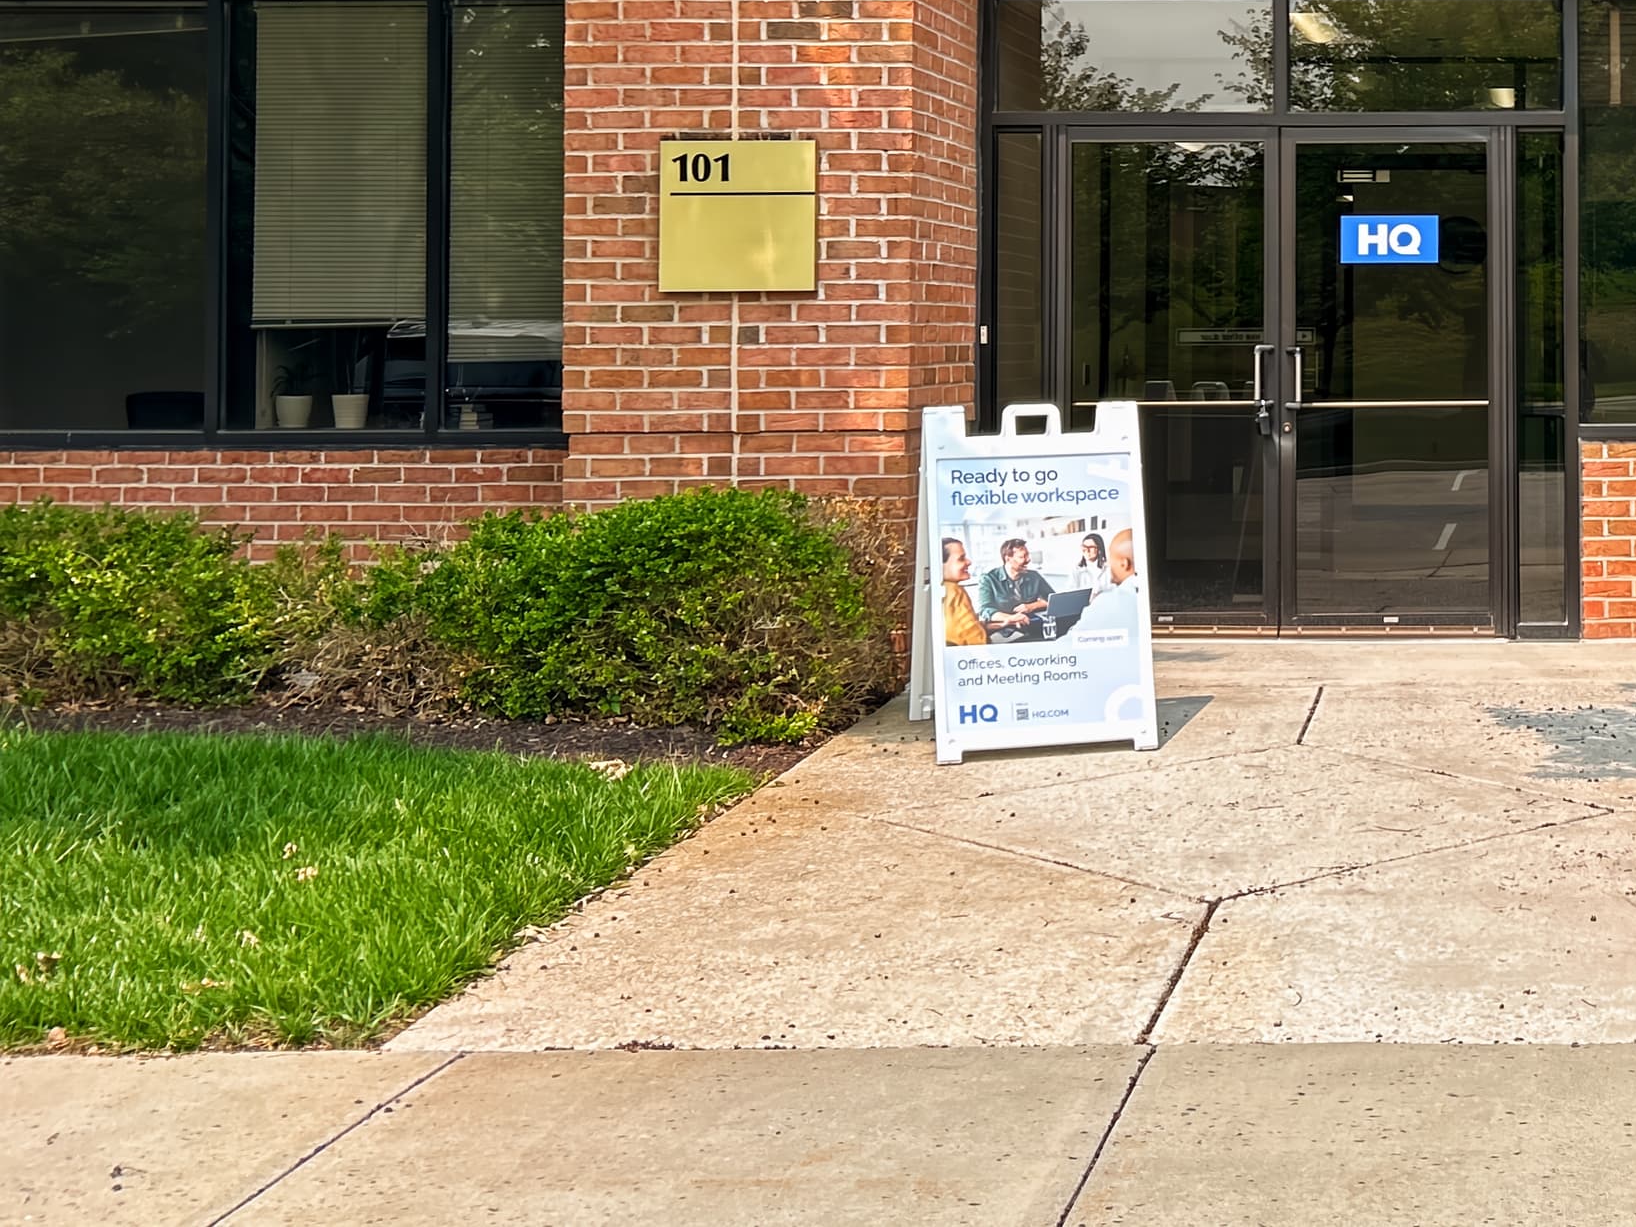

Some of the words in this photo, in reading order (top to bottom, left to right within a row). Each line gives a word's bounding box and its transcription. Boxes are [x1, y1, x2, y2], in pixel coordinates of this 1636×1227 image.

[672, 153, 730, 182] 101
[1357, 223, 1422, 256] HQ
[951, 468, 1008, 487] Ready
[1012, 468, 1030, 482] to
[1035, 469, 1058, 486] go
[951, 489, 1018, 506] flexible
[1021, 487, 1120, 505] workspace
[957, 659, 1005, 671] Offices,
[1008, 654, 1077, 667] Coworking
[958, 674, 983, 687] and
[987, 672, 1040, 685] Meeting
[1044, 670, 1089, 682] Rooms
[959, 703, 998, 724] HQ
[1031, 709, 1069, 718] HQ.COM
